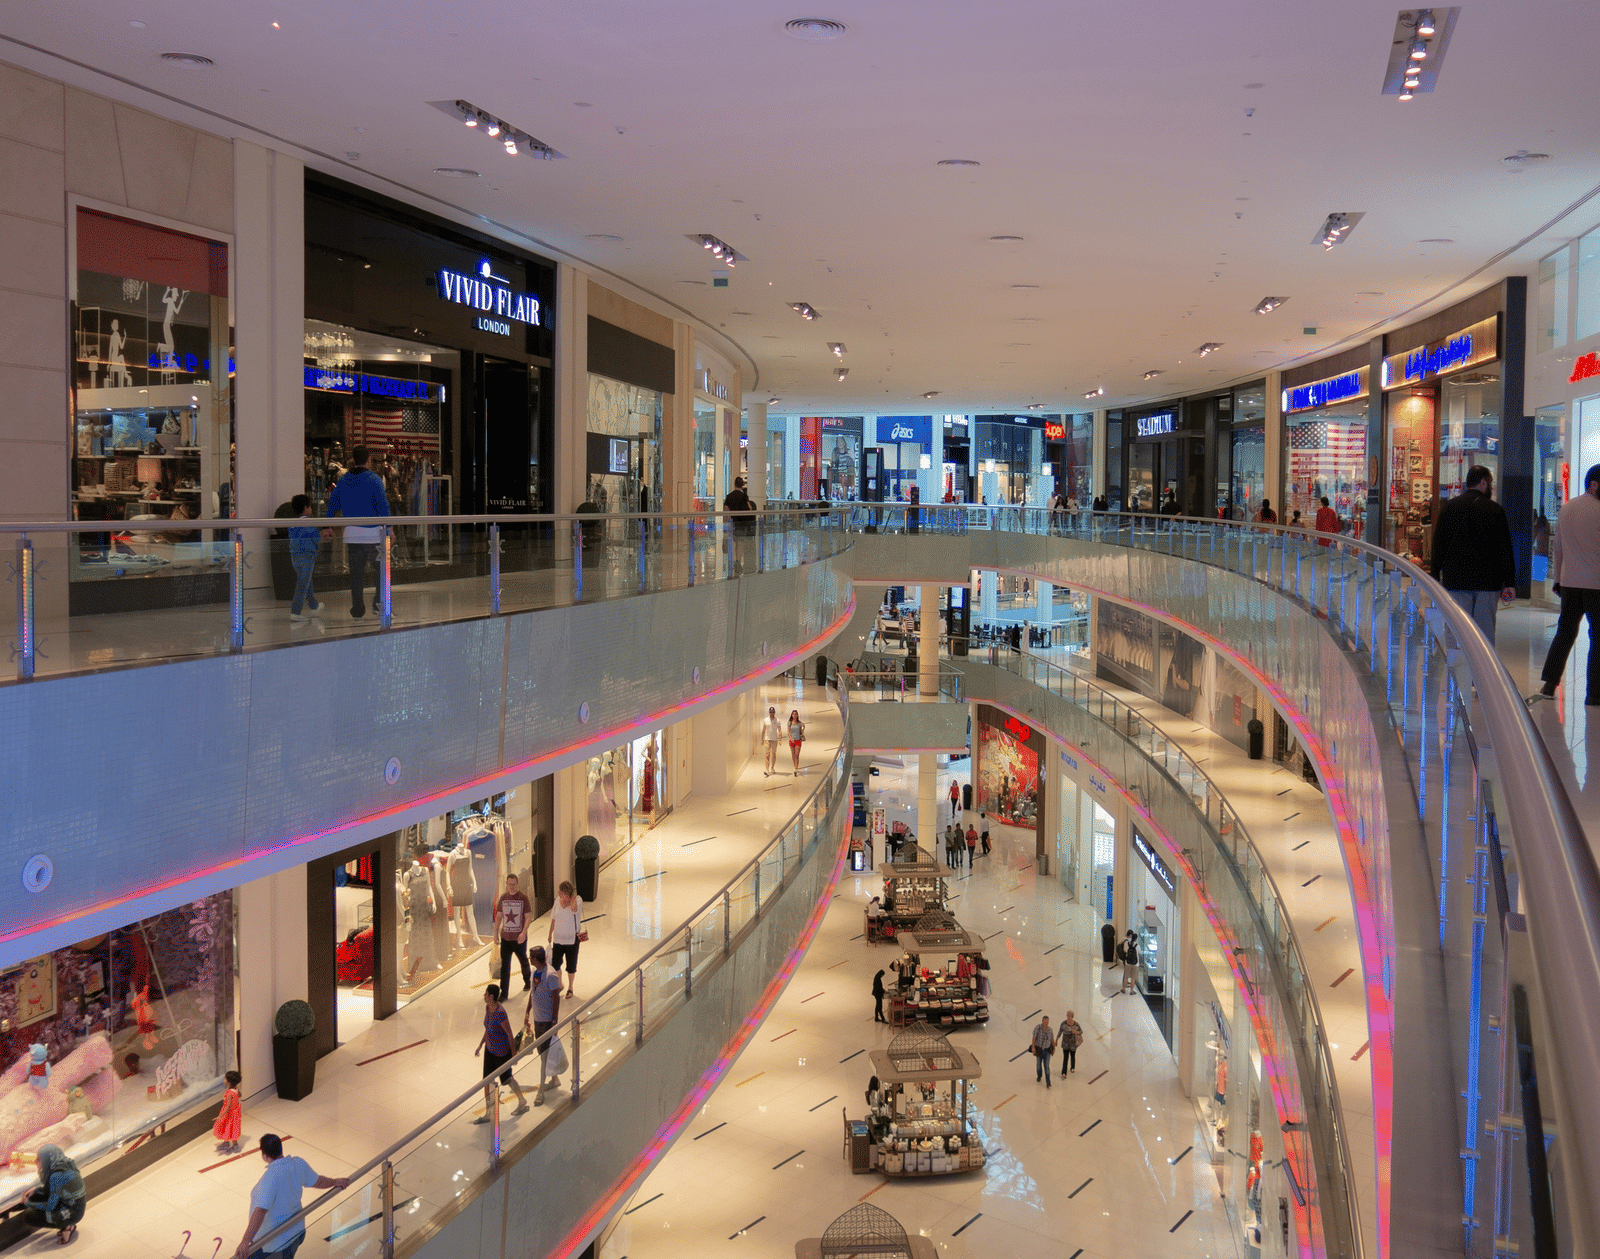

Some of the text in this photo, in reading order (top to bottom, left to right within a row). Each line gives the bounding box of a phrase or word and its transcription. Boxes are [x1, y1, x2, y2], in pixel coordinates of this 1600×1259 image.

[442, 271, 540, 326] VIVID FLAIR
[478, 317, 511, 336] LONDON
[1137, 414, 1172, 436] STADIUM
